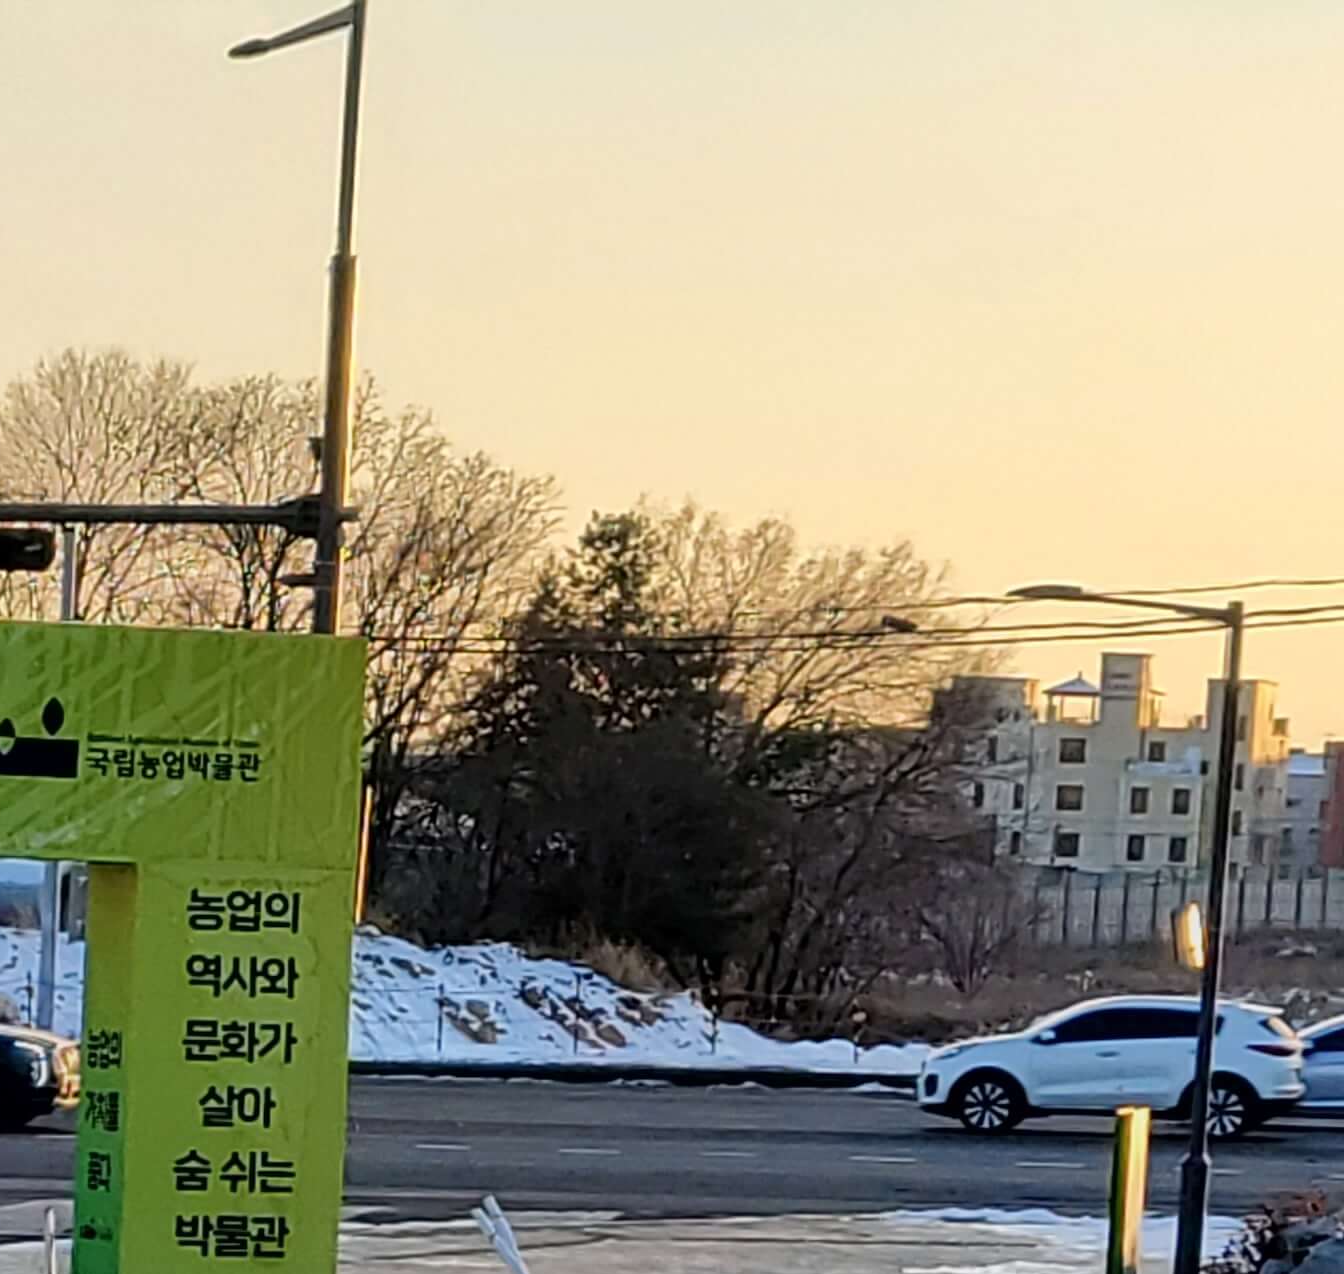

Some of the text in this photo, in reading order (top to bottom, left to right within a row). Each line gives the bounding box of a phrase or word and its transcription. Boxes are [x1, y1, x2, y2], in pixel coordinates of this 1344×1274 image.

[85, 747, 262, 782] 국립농업박물관
[186, 887, 301, 934] 농업의
[185, 954, 300, 999] 역사와
[181, 1019, 299, 1064] 문화가
[198, 1085, 277, 1129] 살아
[173, 1149, 297, 1193] 숨 쉬는
[174, 1215, 291, 1258] 박물관
